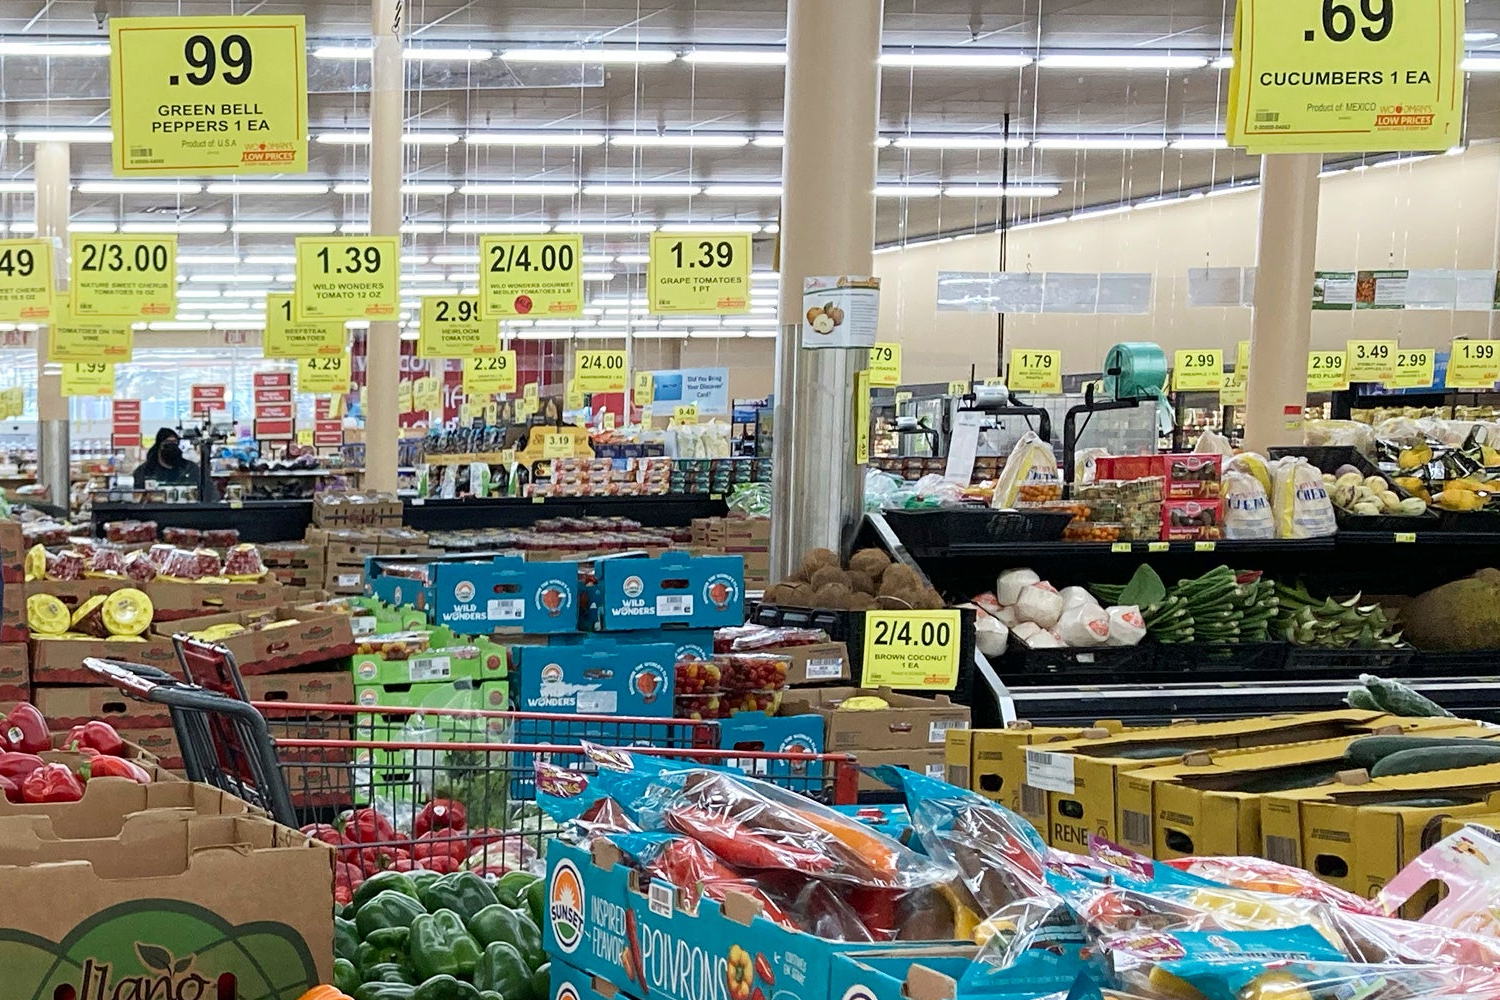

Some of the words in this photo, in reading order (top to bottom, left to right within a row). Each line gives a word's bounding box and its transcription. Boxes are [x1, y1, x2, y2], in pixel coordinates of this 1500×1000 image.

[1304, 0, 1393, 42] .69
[169, 34, 253, 86] .99
[1260, 71, 1384, 86] CUCUMBERS
[1390, 72, 1399, 84] 1
[1406, 71, 1432, 84] EA
[158, 104, 215, 116] GREEN
[221, 103, 263, 115] BELL
[1307, 103, 1334, 112] Product
[1346, 102, 1377, 112] MEXICO
[152, 120, 228, 133] PEPPERS
[234, 120, 241, 131] 1
[248, 120, 270, 131] EA
[1377, 116, 1399, 126] LOW
[1400, 116, 1432, 125] PRICES
[243, 151, 264, 161] LOW
[264, 150, 295, 161] PRICES
[81, 244, 168, 272] 2/3.00
[317, 247, 381, 273] 1.39
[490, 245, 573, 272] 2/4.00
[671, 241, 733, 268] 1.39
[660, 277, 691, 285] GRAPE
[694, 276, 742, 284] TOMATOES
[1357, 345, 1389, 359] 3.49
[1463, 345, 1494, 359] 1.99
[308, 358, 341, 370] 4.29
[474, 357, 507, 370] 2.29
[581, 355, 623, 369] 2/4.00
[1021, 354, 1052, 368] 1.79
[1185, 354, 1214, 367] 2.99
[1313, 356, 1342, 368] 2.99
[1398, 354, 1427, 367] 2.99
[454, 604, 477, 613] WILD
[622, 599, 645, 608] WILD
[443, 612, 487, 621] WONDERS
[612, 606, 655, 617] WONDERS
[874, 621, 950, 647] 2/4.00
[528, 697, 575, 707] WONDERS
[1055, 824, 1088, 847] RENE
[551, 904, 584, 934] SUNSET
[591, 895, 627, 936] INSPIRED
[593, 926, 624, 967] FLAVOR
